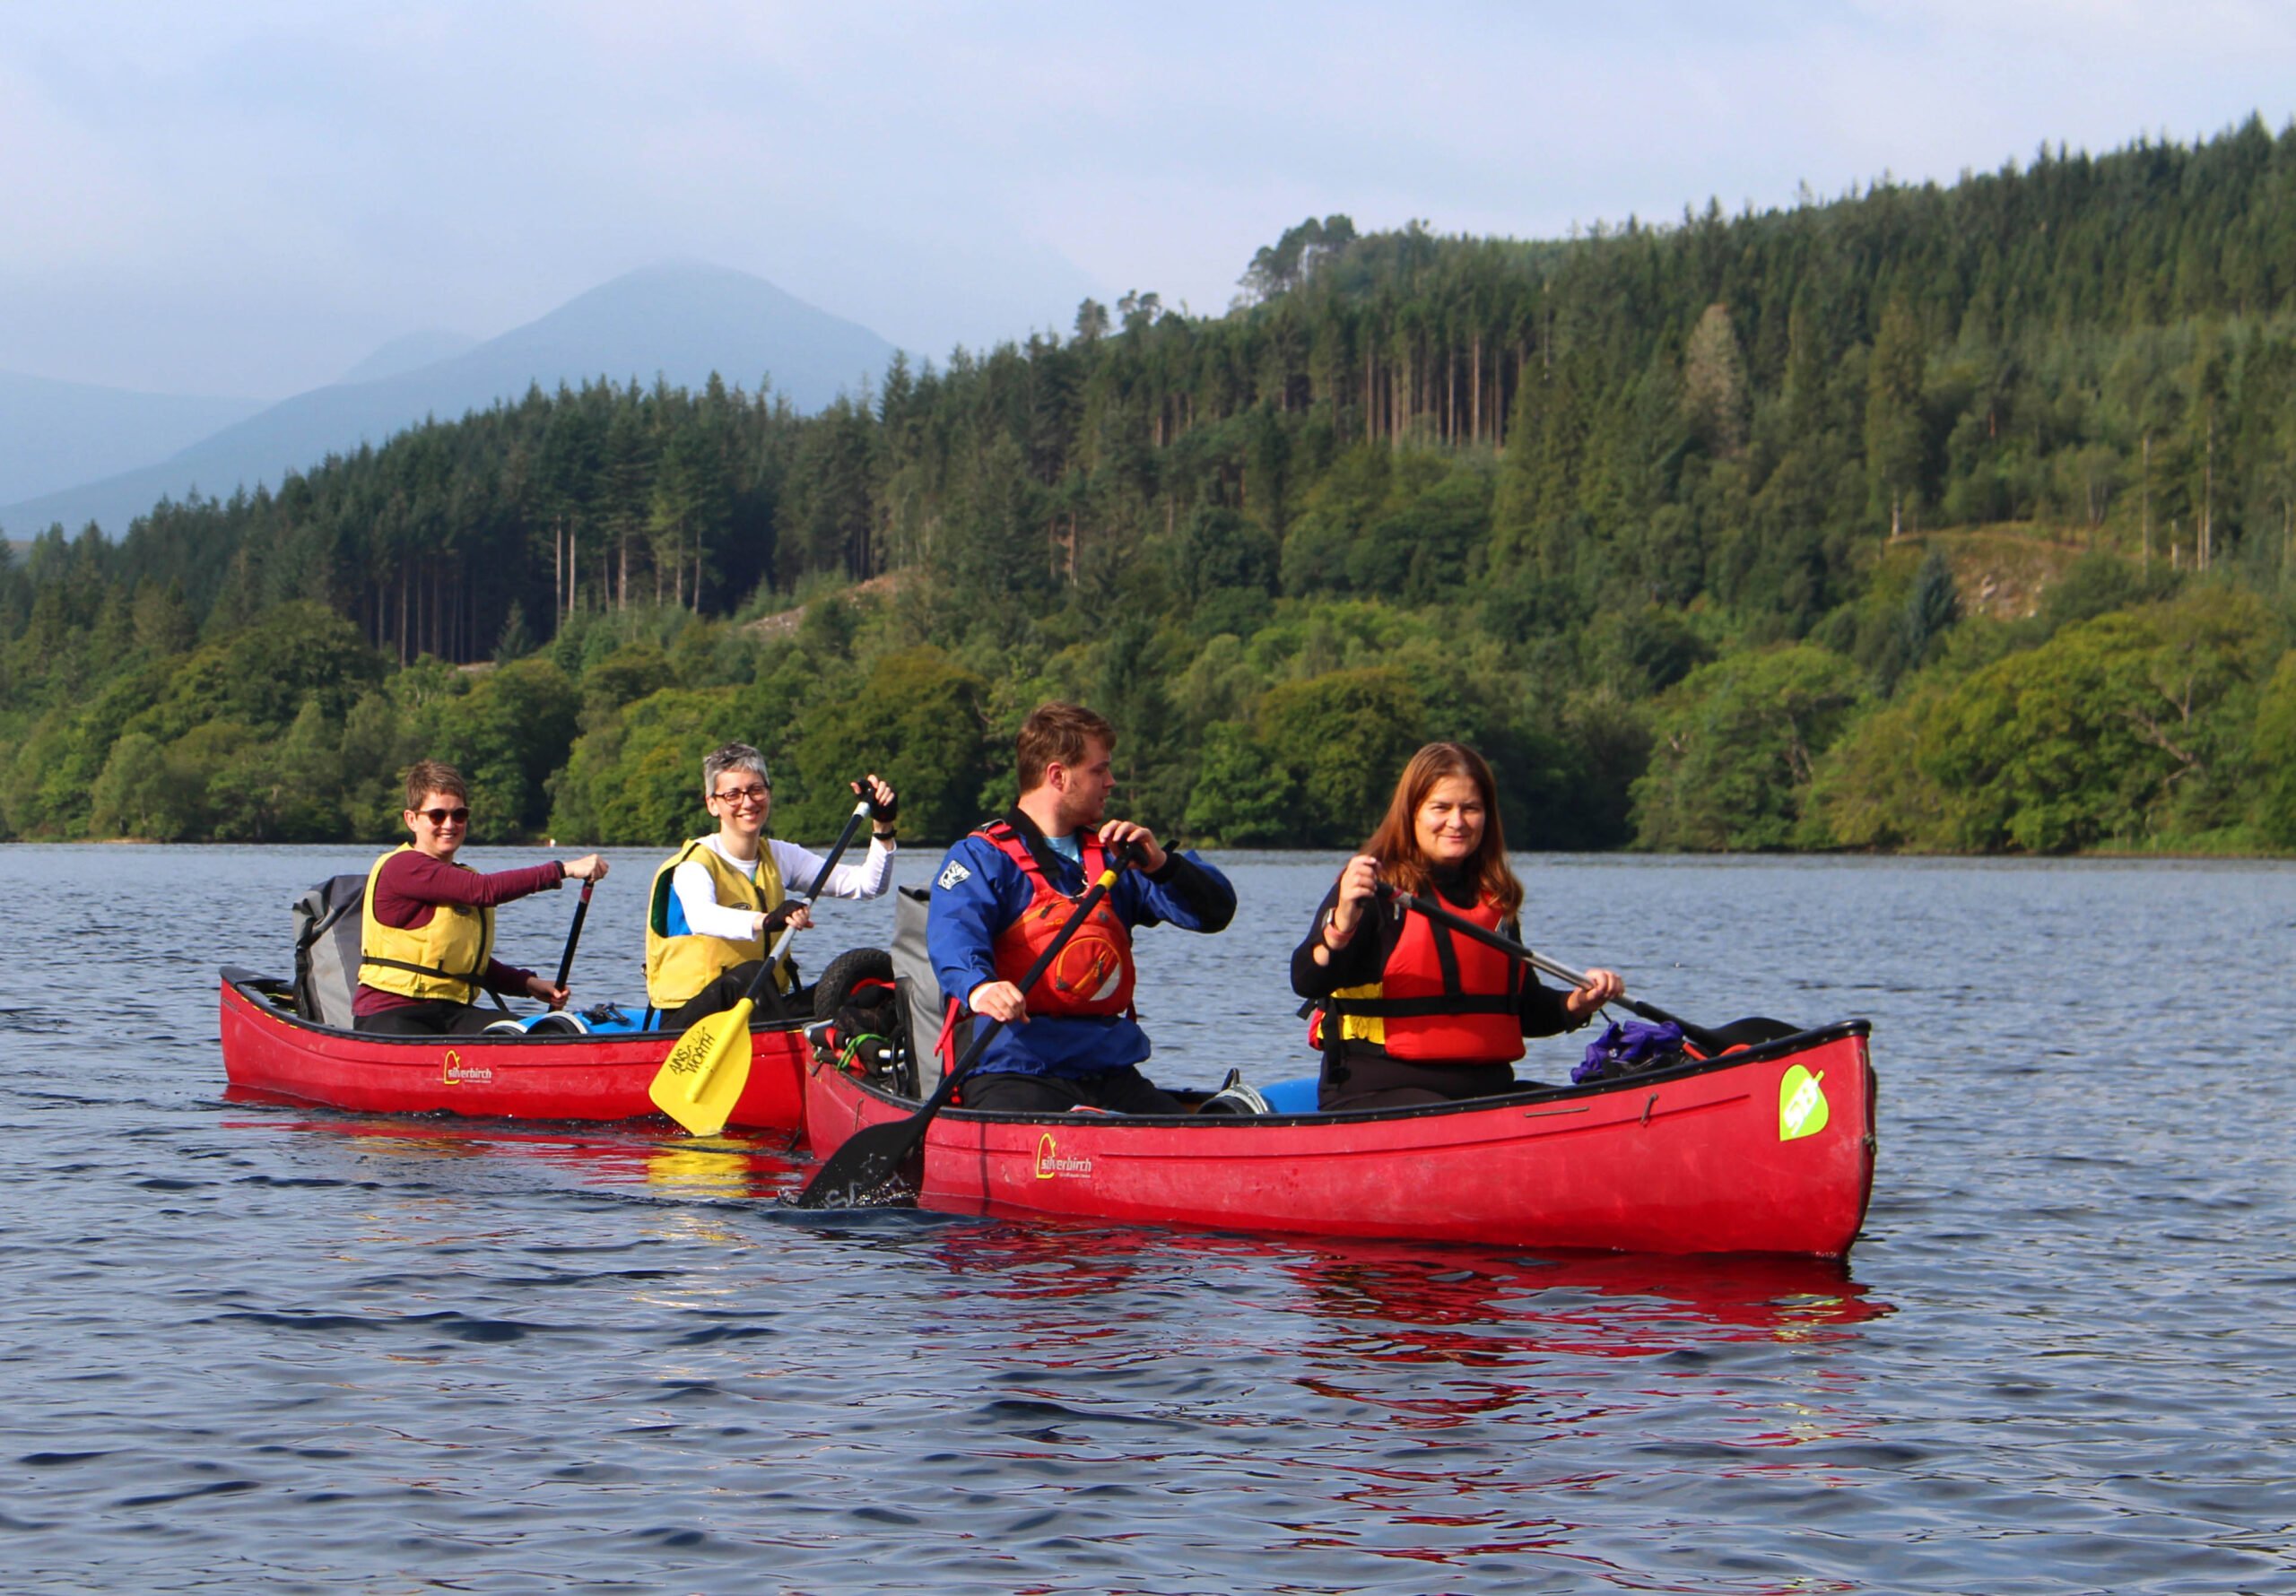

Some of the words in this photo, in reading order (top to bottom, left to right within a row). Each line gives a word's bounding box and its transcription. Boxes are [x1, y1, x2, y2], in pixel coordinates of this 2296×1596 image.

[684, 1033, 716, 1073] WORTH
[448, 1067, 492, 1079] silverbirch
[1041, 1156, 1091, 1172] silverbirch
